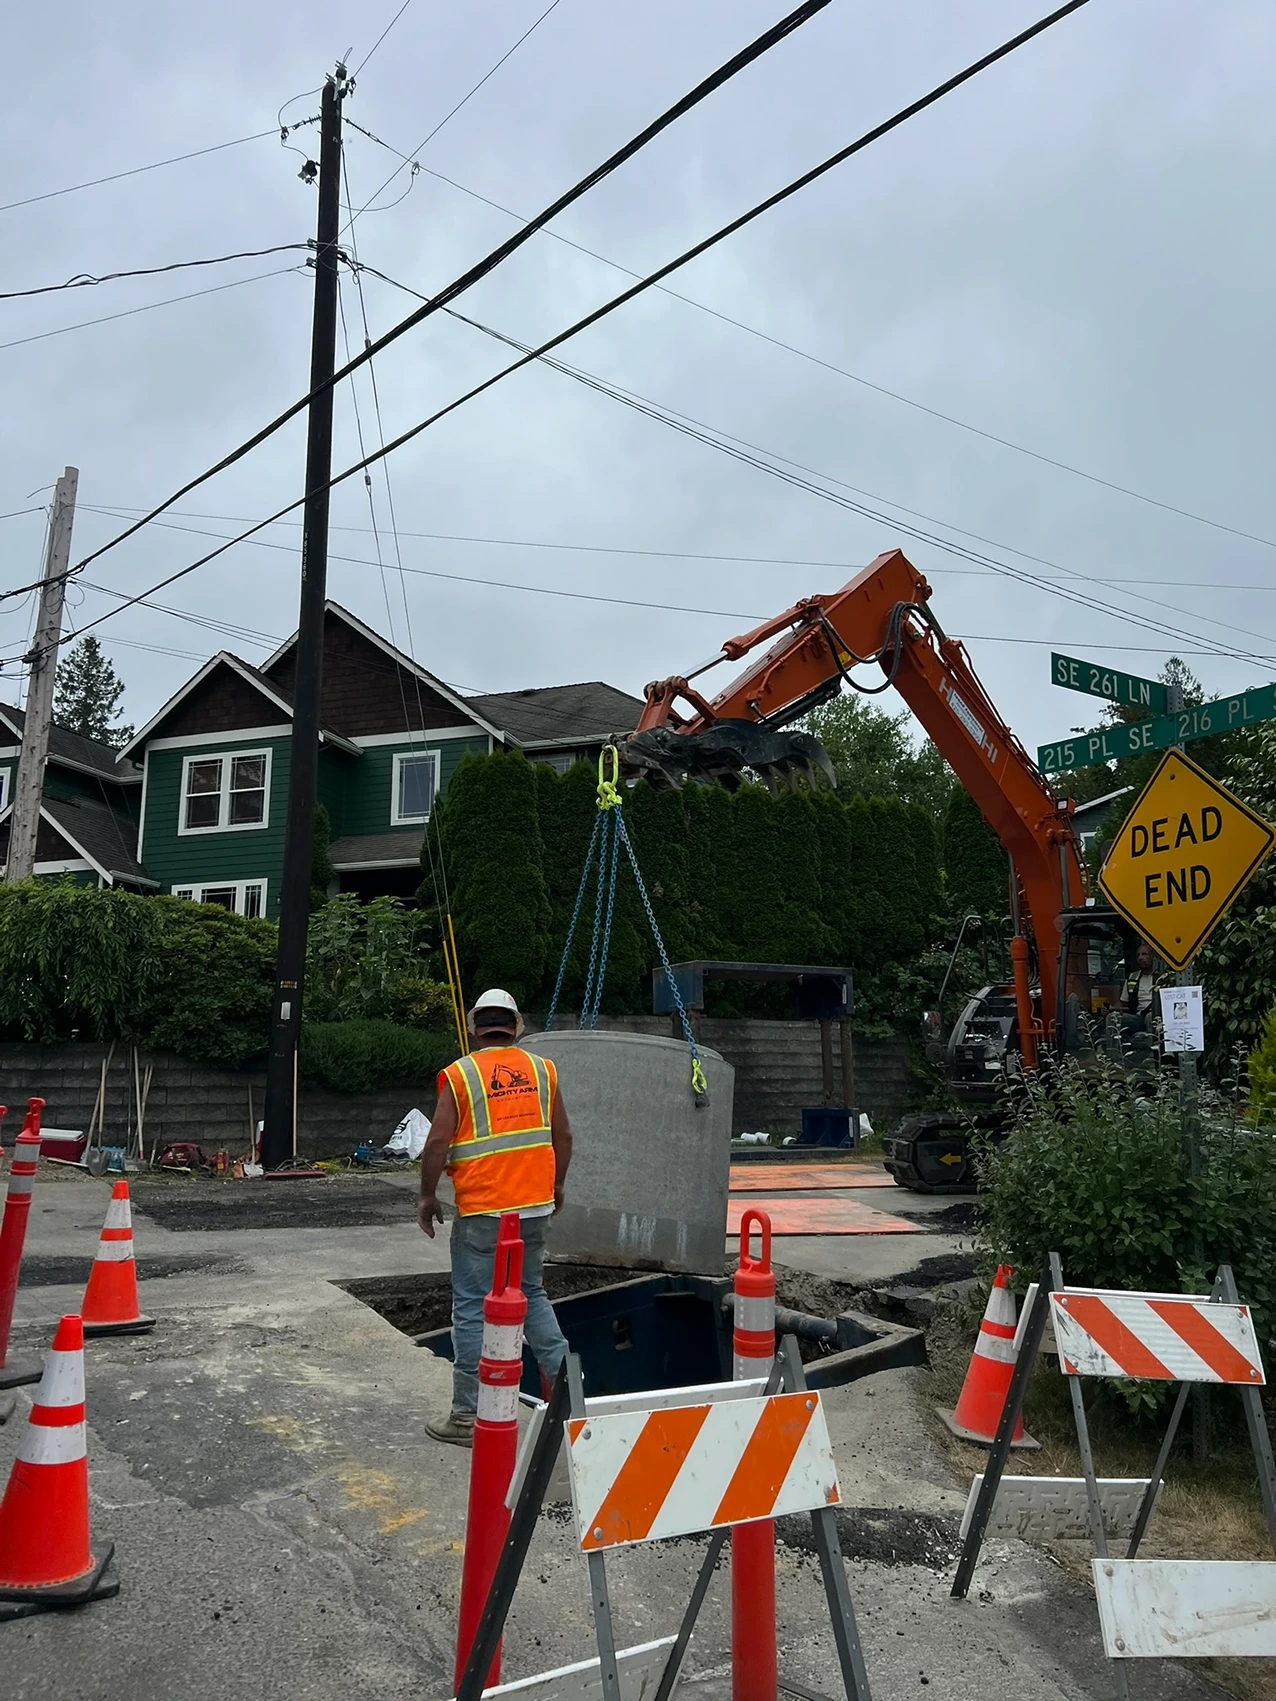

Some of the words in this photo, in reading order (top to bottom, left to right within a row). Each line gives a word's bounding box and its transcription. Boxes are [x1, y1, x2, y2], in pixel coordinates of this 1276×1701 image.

[1057, 659, 1079, 686] SE
[1090, 669, 1118, 697] 261
[1128, 680, 1151, 706] LN
[1179, 709, 1211, 738] 216
[1228, 698, 1254, 724] PL
[1044, 743, 1075, 770] 215
[1089, 735, 1114, 759] PL
[1129, 724, 1154, 750] SE
[1130, 805, 1223, 859] DEAD
[1144, 864, 1212, 909] END
[487, 1089, 520, 1100] MIGHTY
[518, 1086, 538, 1095] ARM
